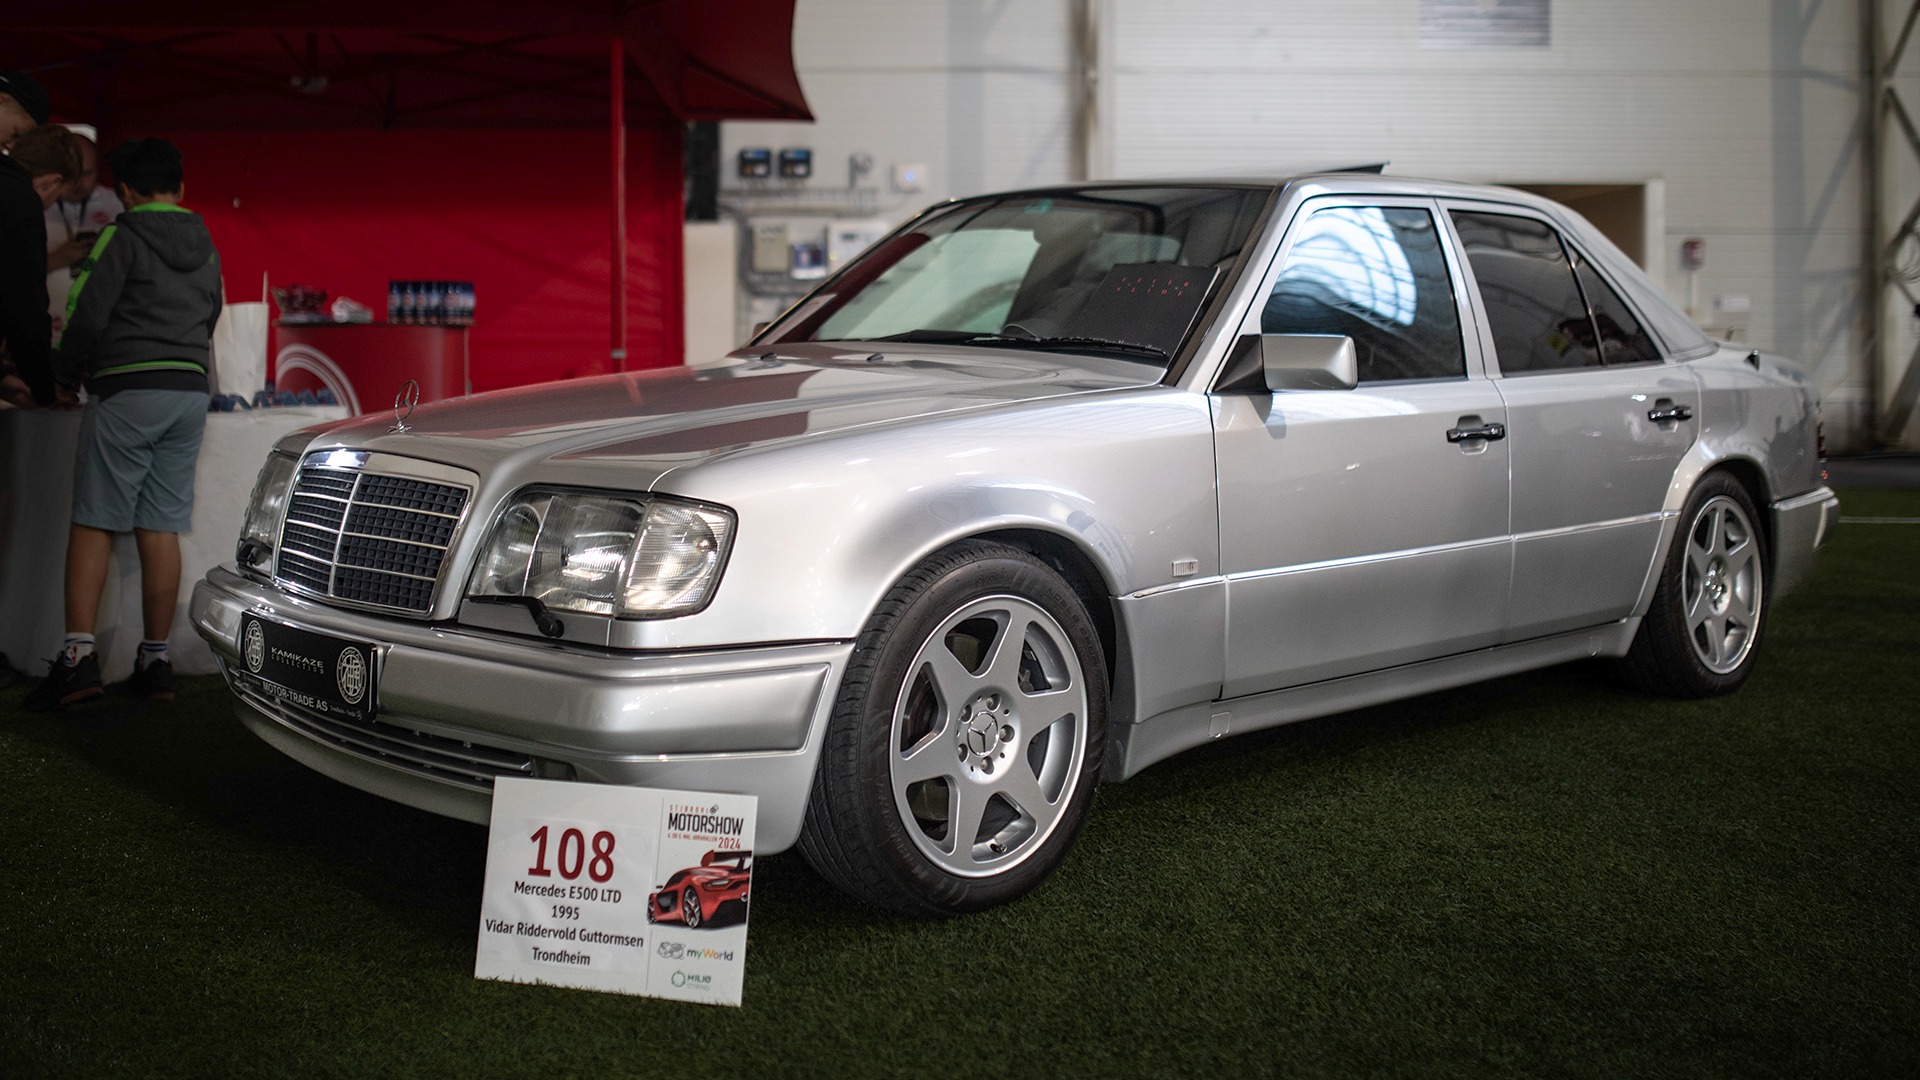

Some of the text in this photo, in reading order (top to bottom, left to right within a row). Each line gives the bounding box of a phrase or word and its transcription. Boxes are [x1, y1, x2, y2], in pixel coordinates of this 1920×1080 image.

[271, 646, 324, 669] KAMIKAZE
[271, 653, 325, 675] COLLECTION
[262, 681, 315, 708] MOTOR-TRADE
[316, 699, 329, 712] AS
[668, 812, 744, 836] MOTORSHOW
[718, 836, 741, 850] 2024
[527, 825, 616, 884] 108
[514, 881, 622, 904] Mercedes E500 LTD
[551, 904, 580, 921] 1995
[485, 919, 644, 948] Vidar Riddervold Guttormsen
[532, 946, 591, 966] Trondheim
[686, 948, 734, 962] myWorld
[687, 974, 712, 984] MILJØ
